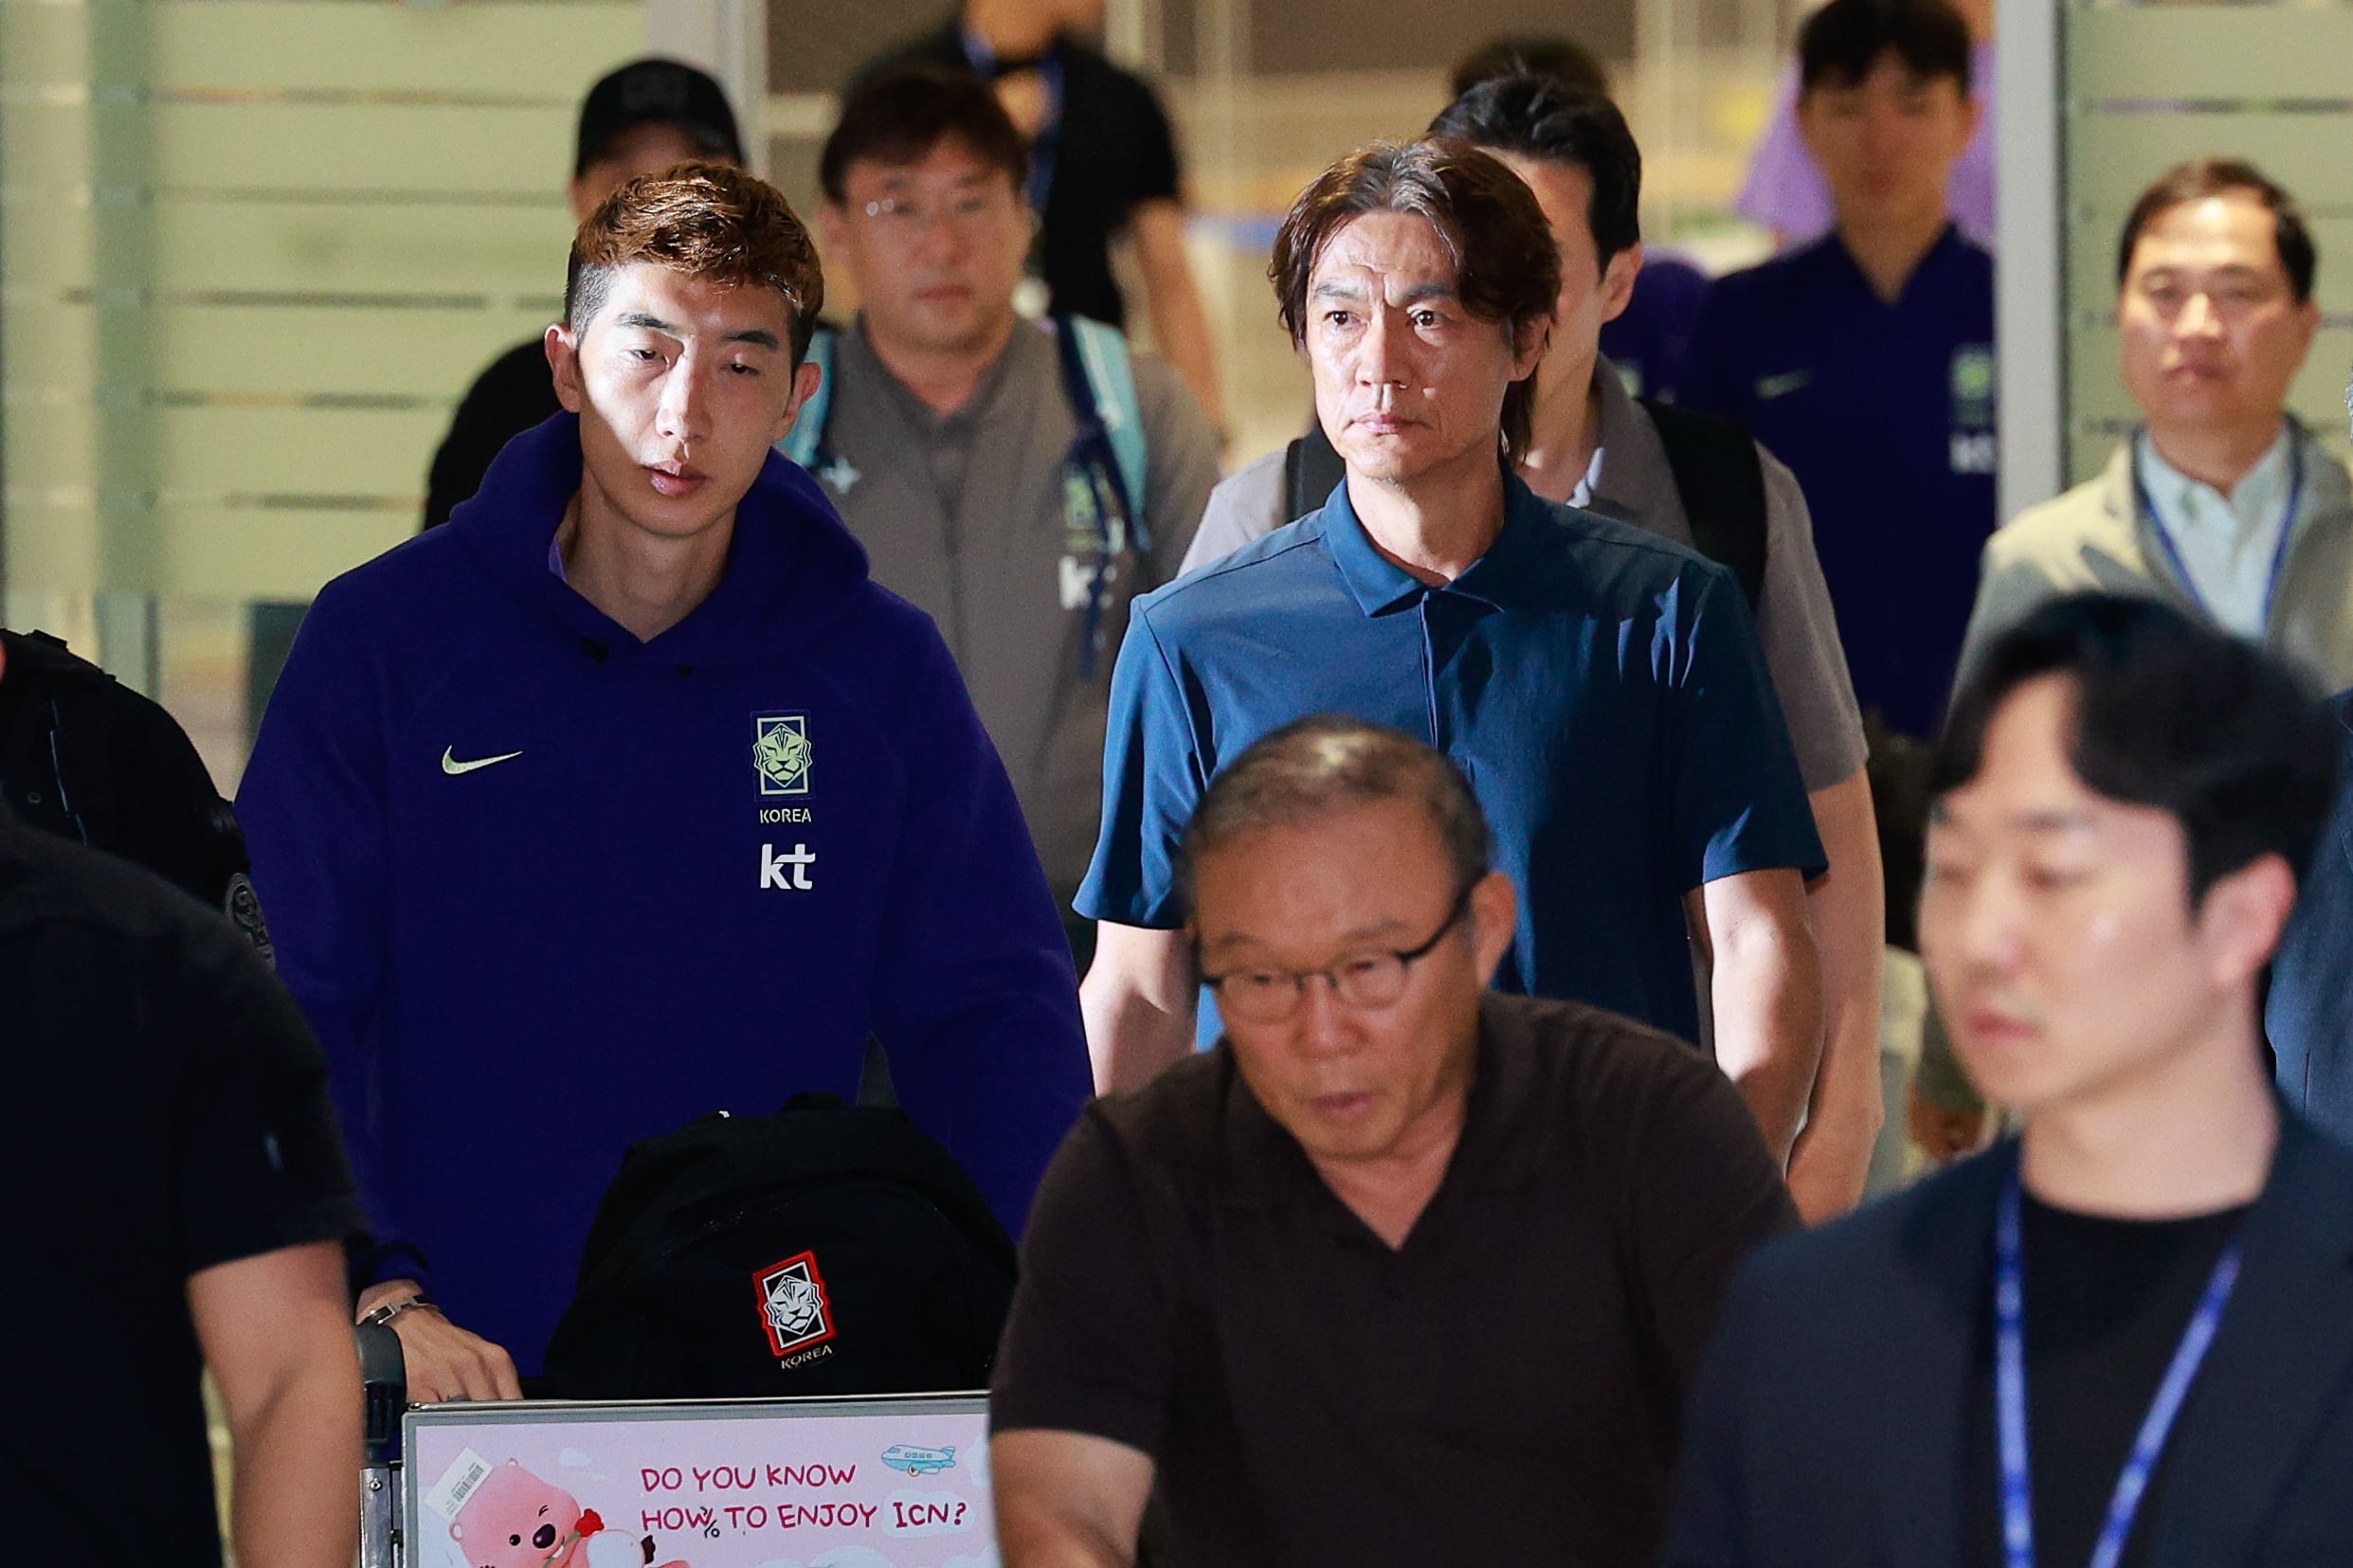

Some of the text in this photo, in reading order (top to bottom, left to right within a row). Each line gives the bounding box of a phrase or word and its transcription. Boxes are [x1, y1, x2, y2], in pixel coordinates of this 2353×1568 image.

[759, 808, 811, 823] KOREA
[760, 843, 816, 890] kt
[780, 1344, 833, 1369] KOREA
[641, 1464, 856, 1492] DO YOU KNOW
[641, 1501, 967, 1531] HOW TO ENJOY ICN?
